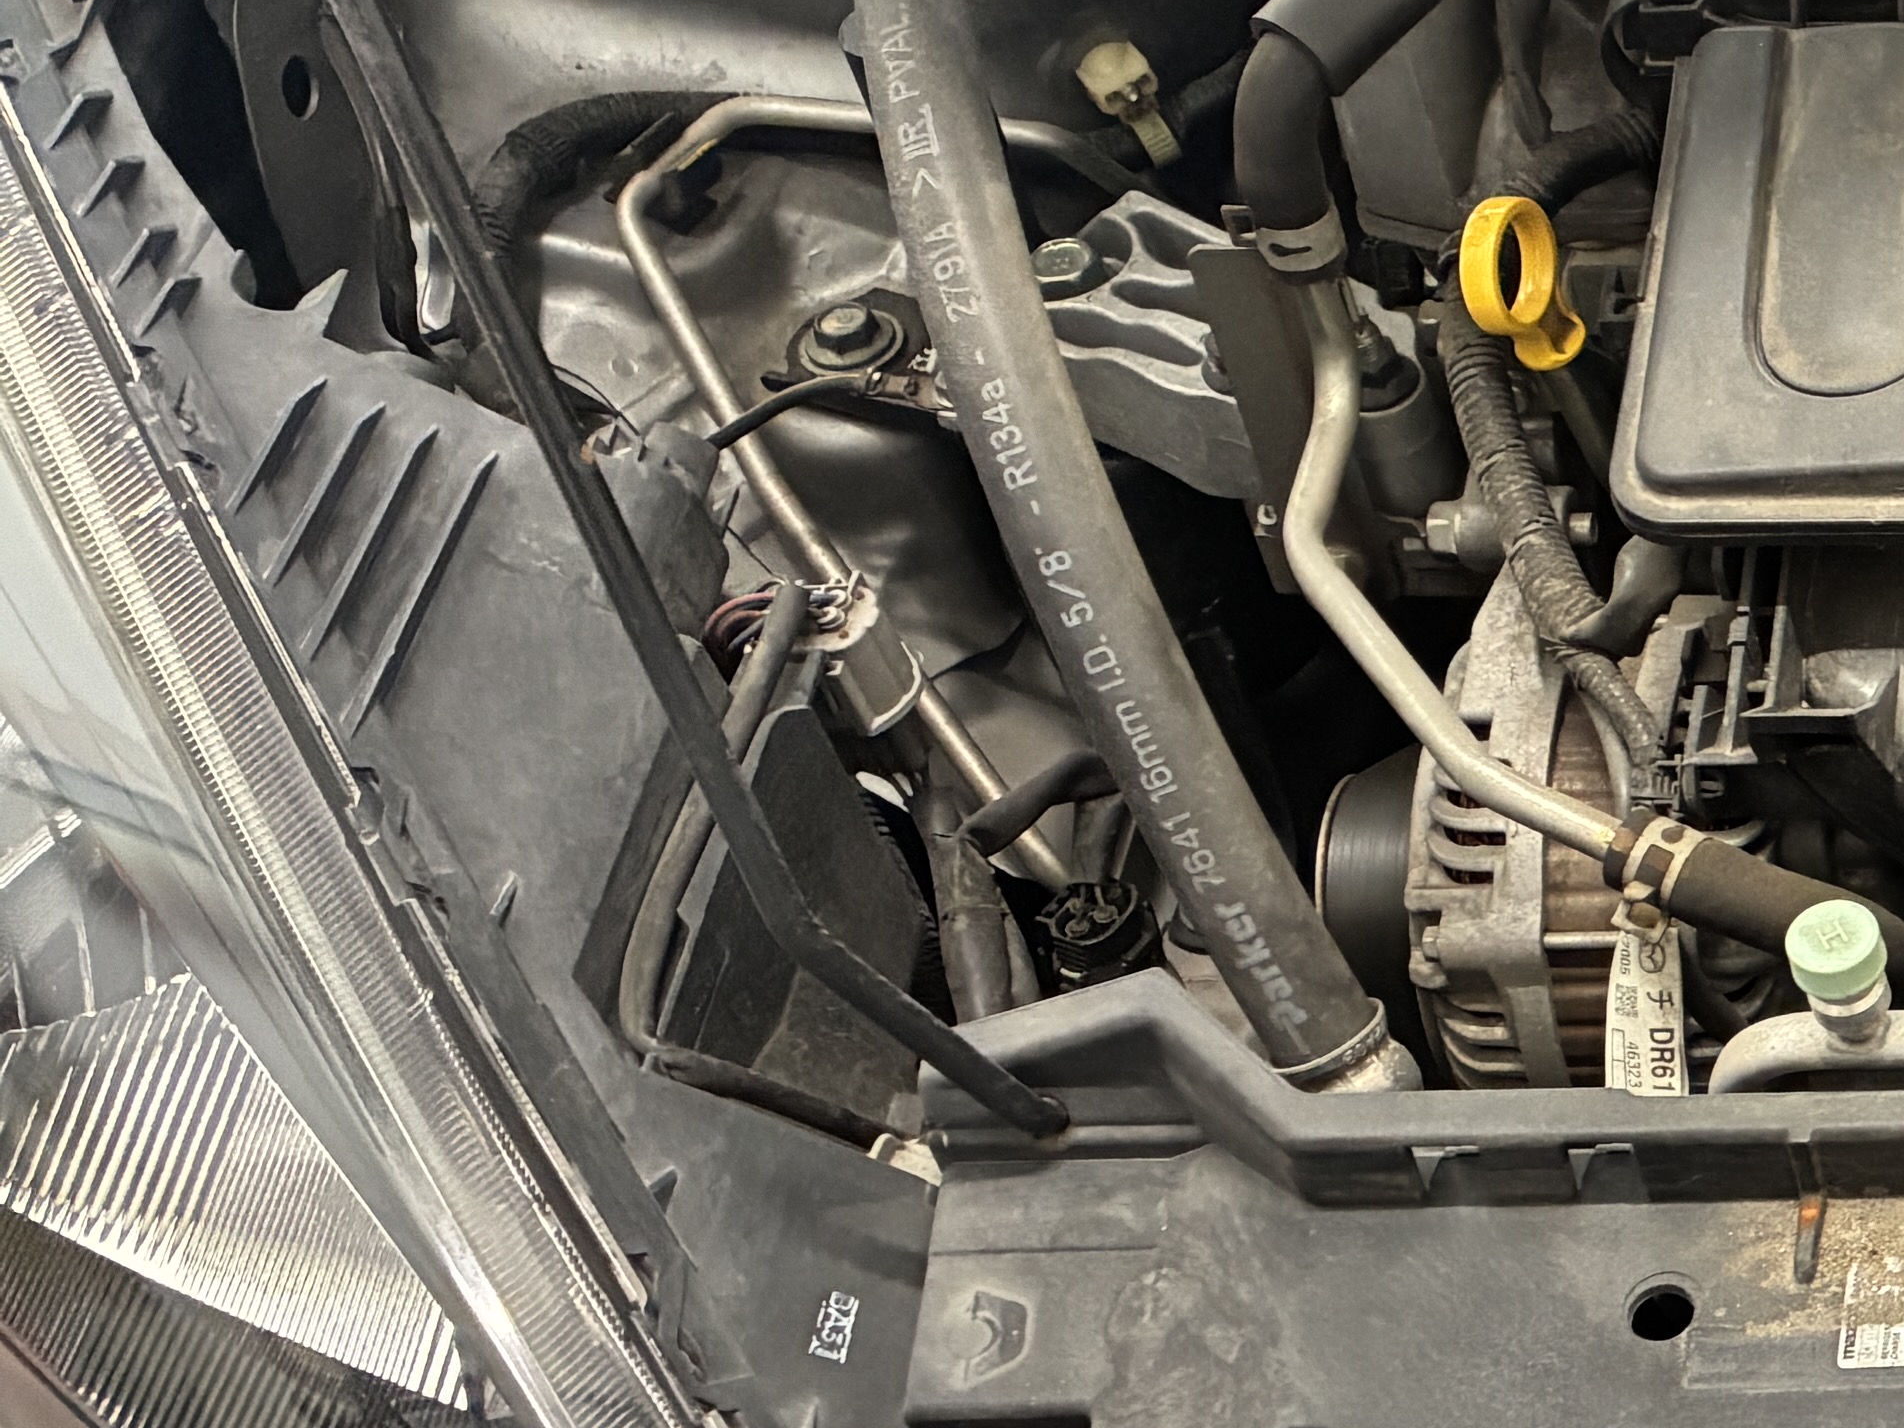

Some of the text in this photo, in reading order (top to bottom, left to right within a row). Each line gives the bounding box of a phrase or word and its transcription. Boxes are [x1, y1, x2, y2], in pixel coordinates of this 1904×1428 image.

[981, 377, 1037, 491] R134a
[1082, 632, 1127, 692] I.D.
[1115, 700, 1179, 804] 16mm
[1160, 811, 1309, 1031] Parker 7641
[1815, 920, 1849, 951] H
[1648, 1027, 1677, 1092] DR61
